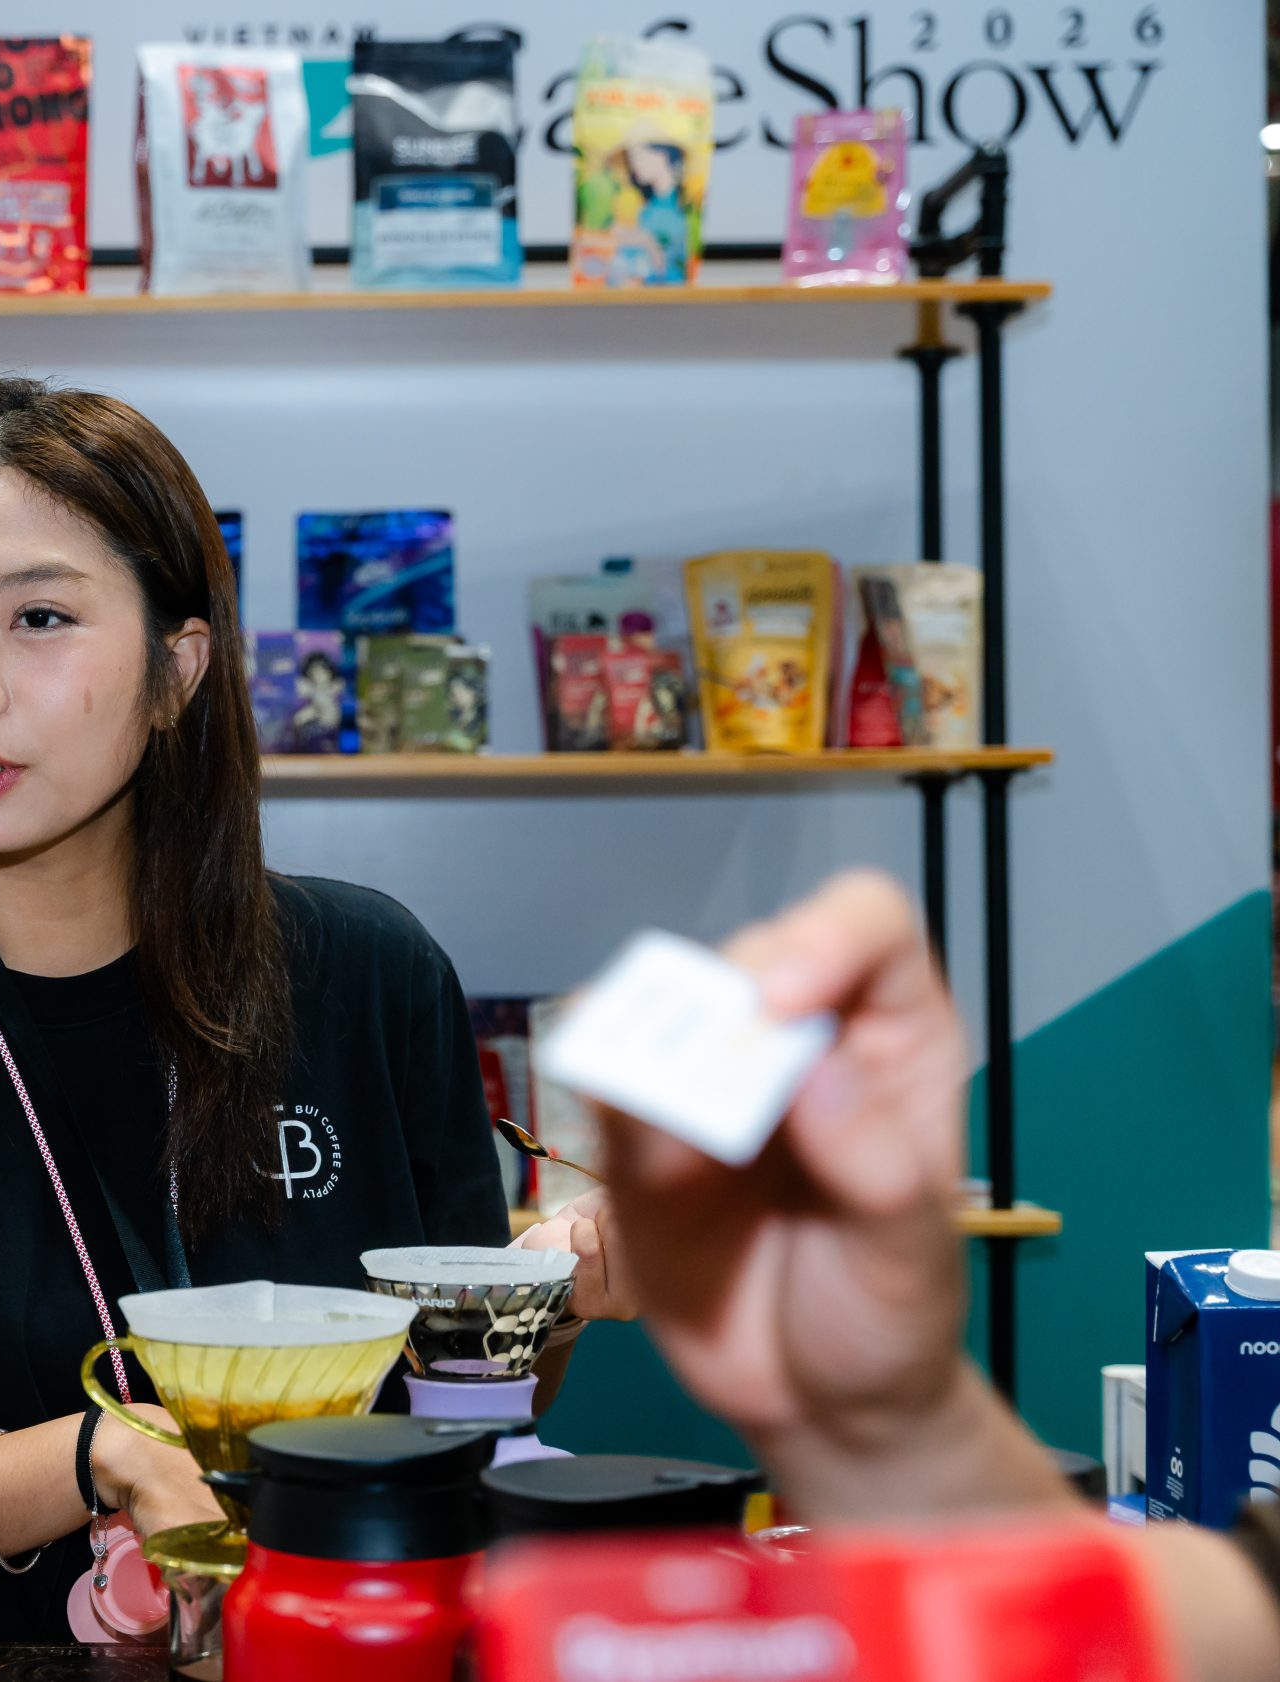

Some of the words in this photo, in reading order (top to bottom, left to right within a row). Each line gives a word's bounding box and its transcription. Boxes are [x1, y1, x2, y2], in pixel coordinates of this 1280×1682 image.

[913, 9, 1165, 51] 2026
[295, 1105, 319, 1117] BUI
[321, 1116, 341, 1168] COFFEE
[302, 1172, 339, 1199] SUPPLY
[411, 1296, 456, 1309] HARIO
[1240, 1341, 1280, 1356] noo
